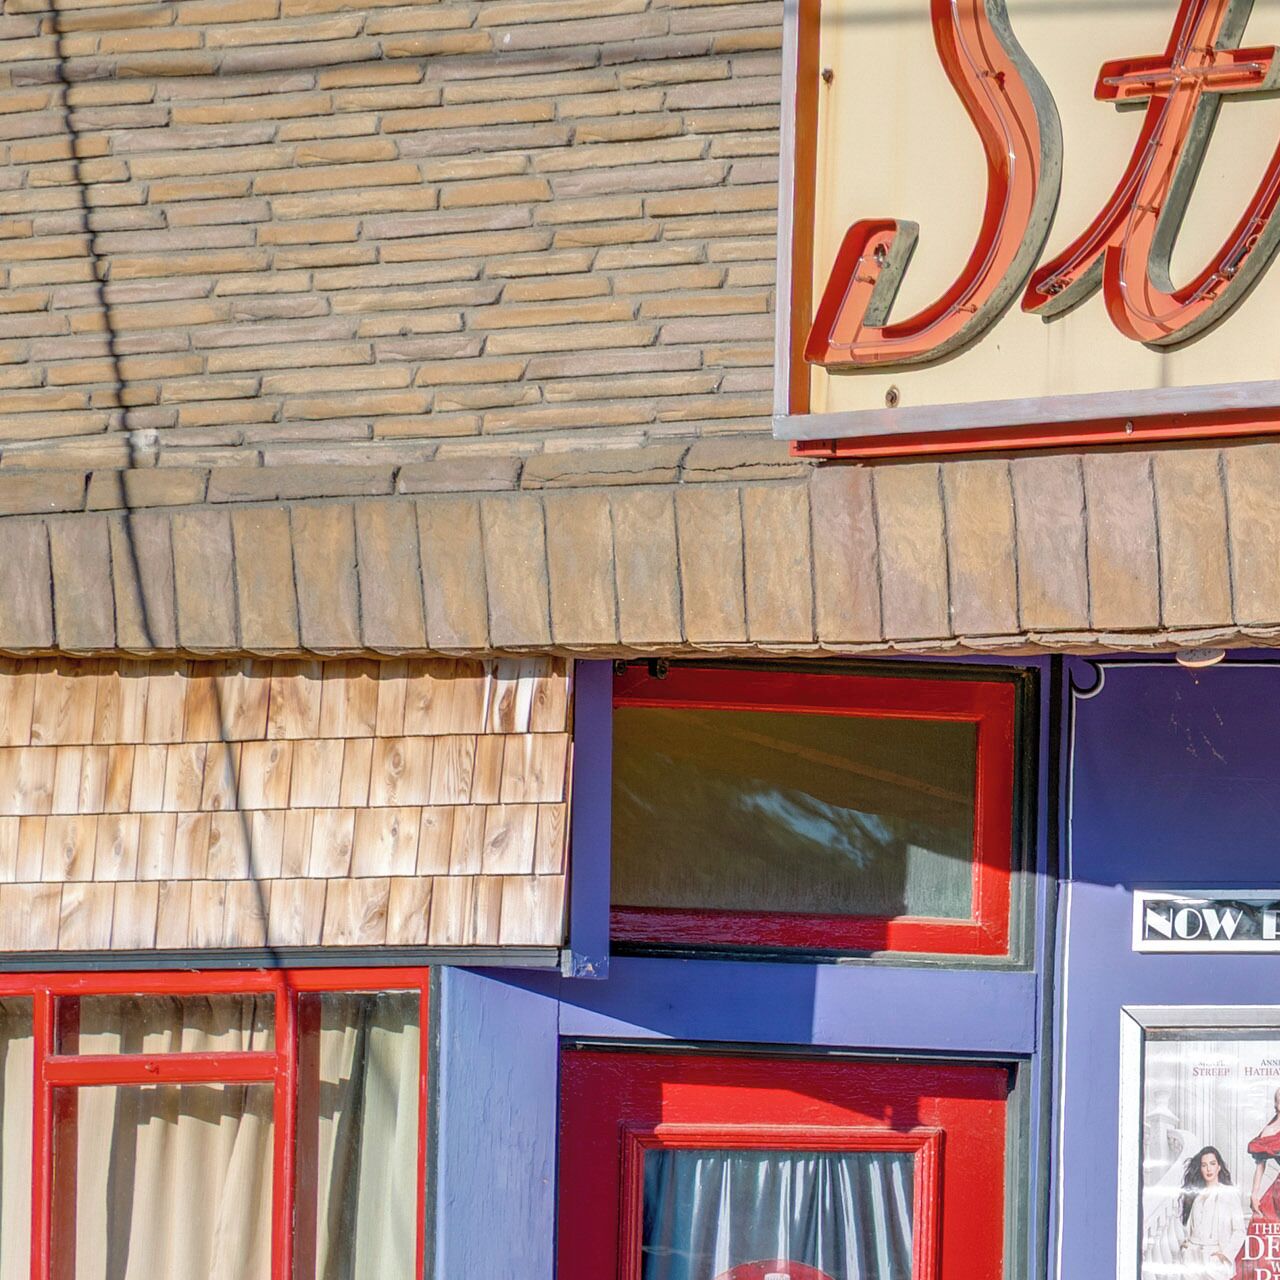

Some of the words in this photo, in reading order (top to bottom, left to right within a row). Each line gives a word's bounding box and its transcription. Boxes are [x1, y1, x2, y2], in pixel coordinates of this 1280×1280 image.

[1145, 907, 1243, 940] NOW
[1192, 1066, 1230, 1076] STREEP
[1252, 1222, 1280, 1234] THE
